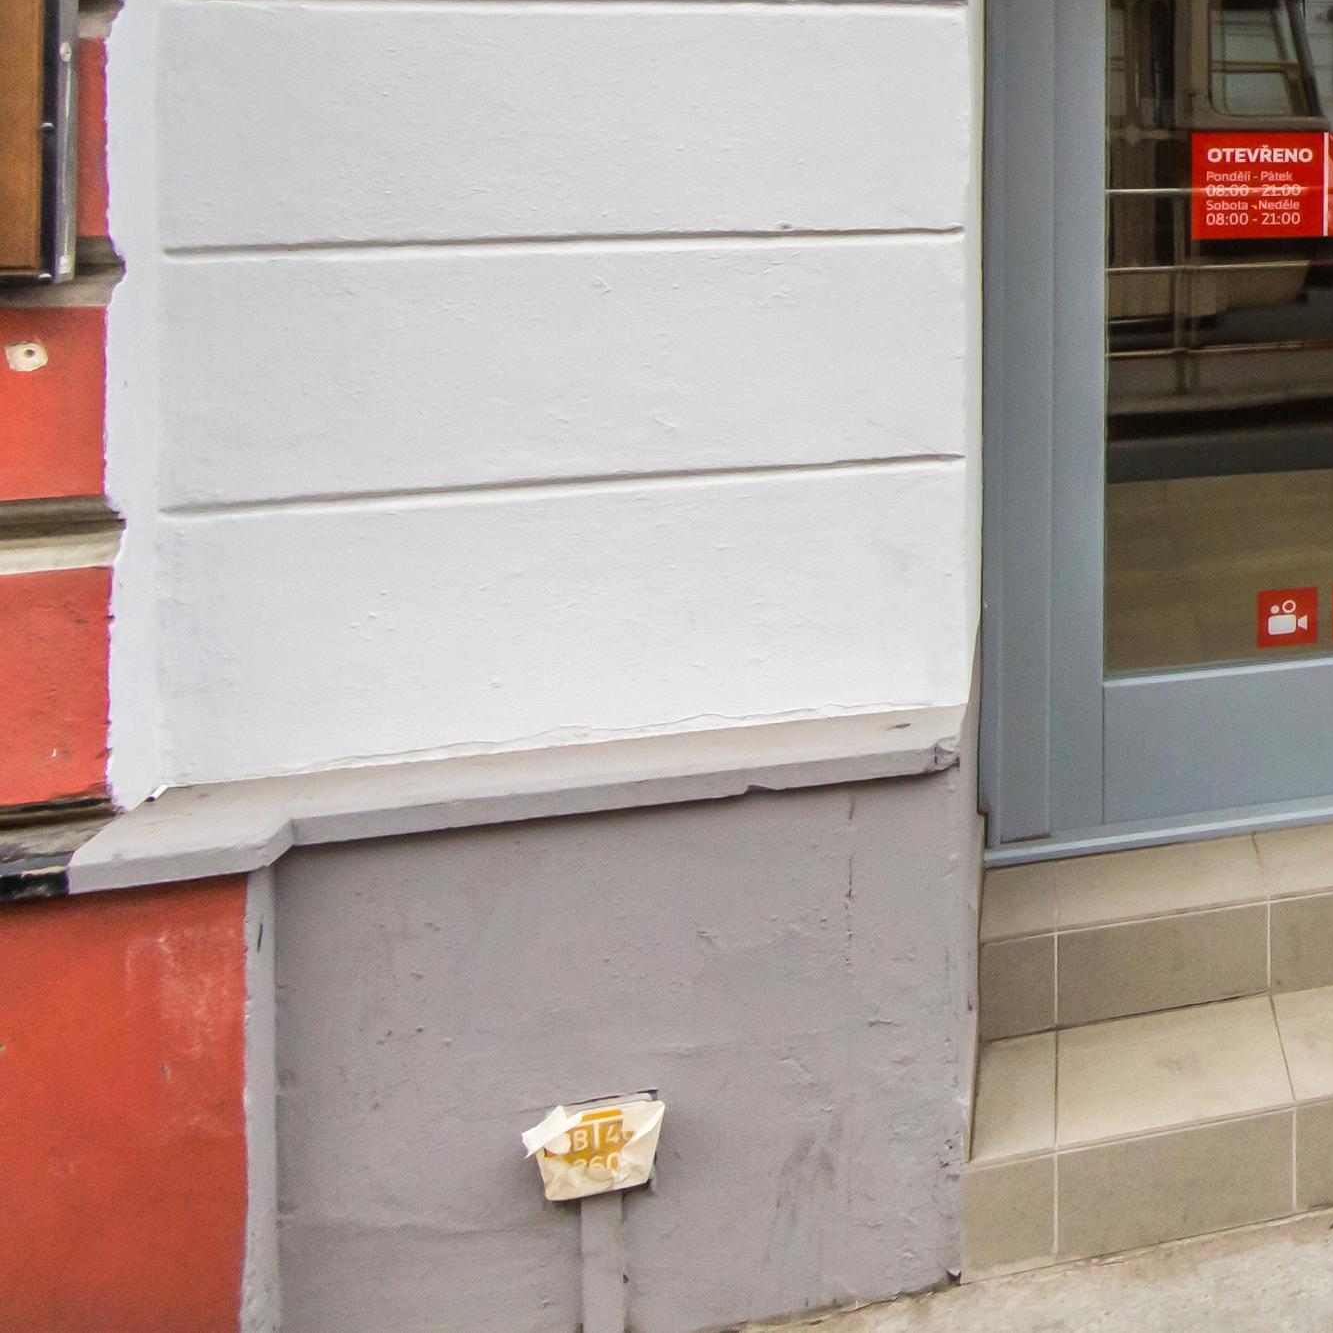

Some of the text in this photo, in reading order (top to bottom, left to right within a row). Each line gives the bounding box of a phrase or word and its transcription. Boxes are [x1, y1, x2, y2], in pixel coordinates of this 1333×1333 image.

[1207, 145, 1313, 163] OTEVŘENO
[1261, 170, 1293, 182] Pátek
[1206, 184, 1249, 197] 08:00
[1206, 200, 1248, 211] Sobota
[1258, 199, 1300, 210] Neděle
[1206, 212, 1249, 225] 08:00
[1261, 212, 1301, 225] 21:00
